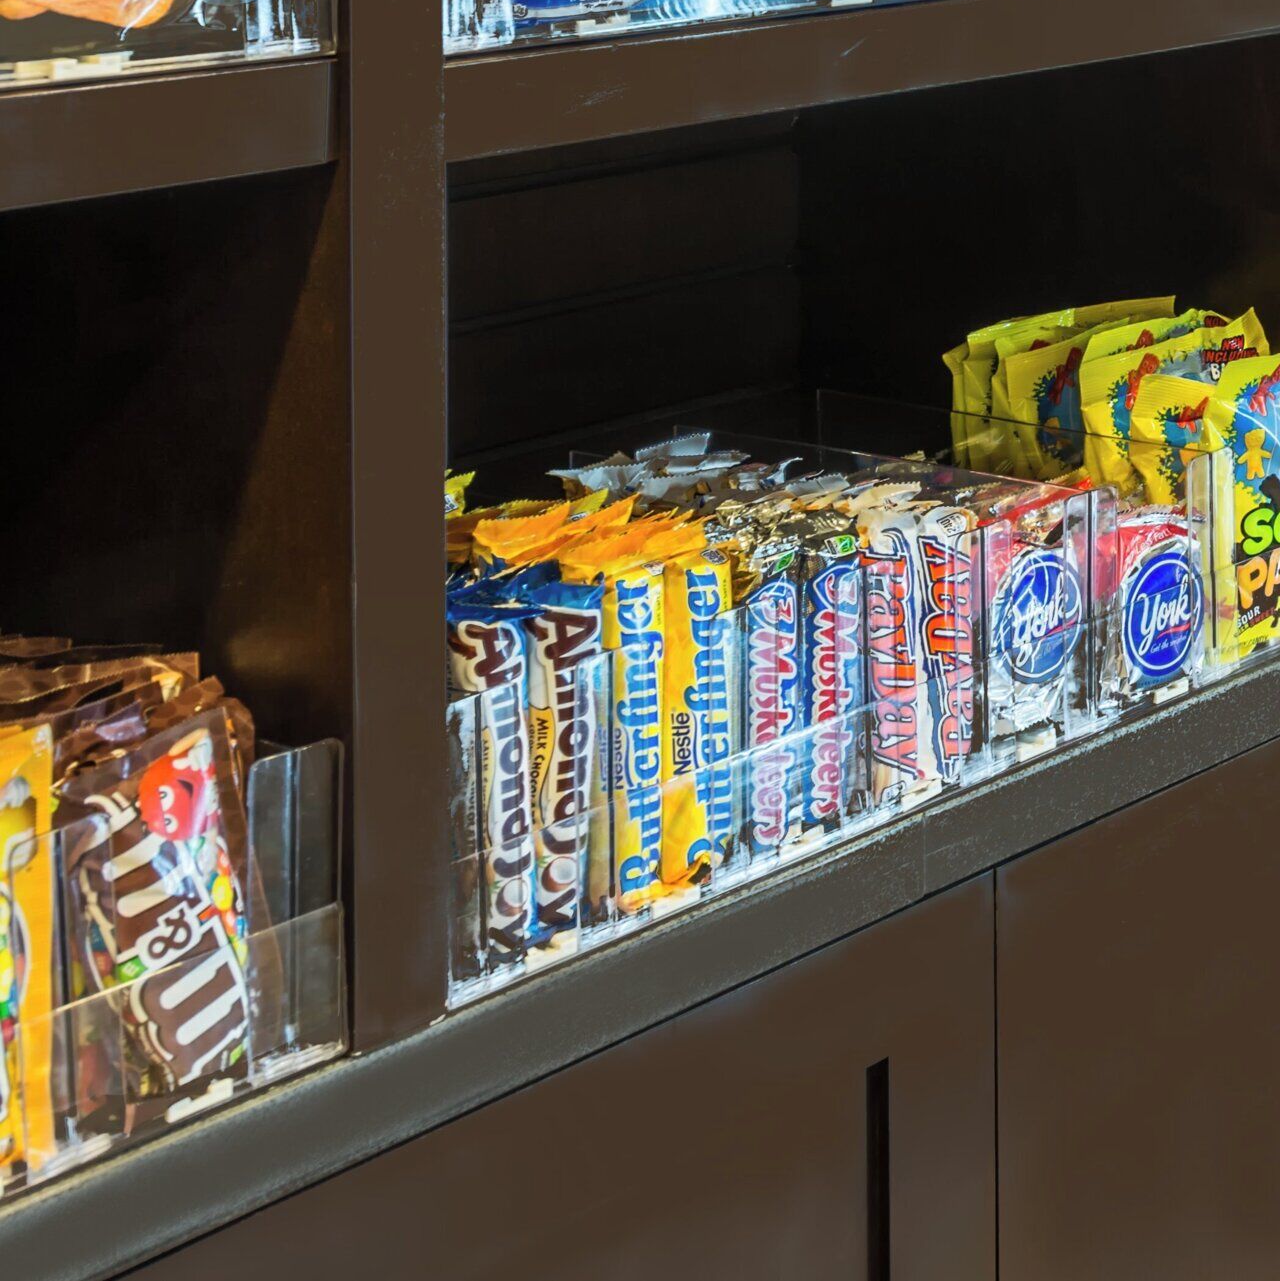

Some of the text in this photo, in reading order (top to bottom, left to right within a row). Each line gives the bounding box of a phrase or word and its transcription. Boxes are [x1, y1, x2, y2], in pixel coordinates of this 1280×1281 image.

[1137, 575, 1191, 657] York
[1236, 606, 1261, 629] SOUR
[535, 717, 548, 751] MILK
[616, 578, 663, 896] Butterfinger
